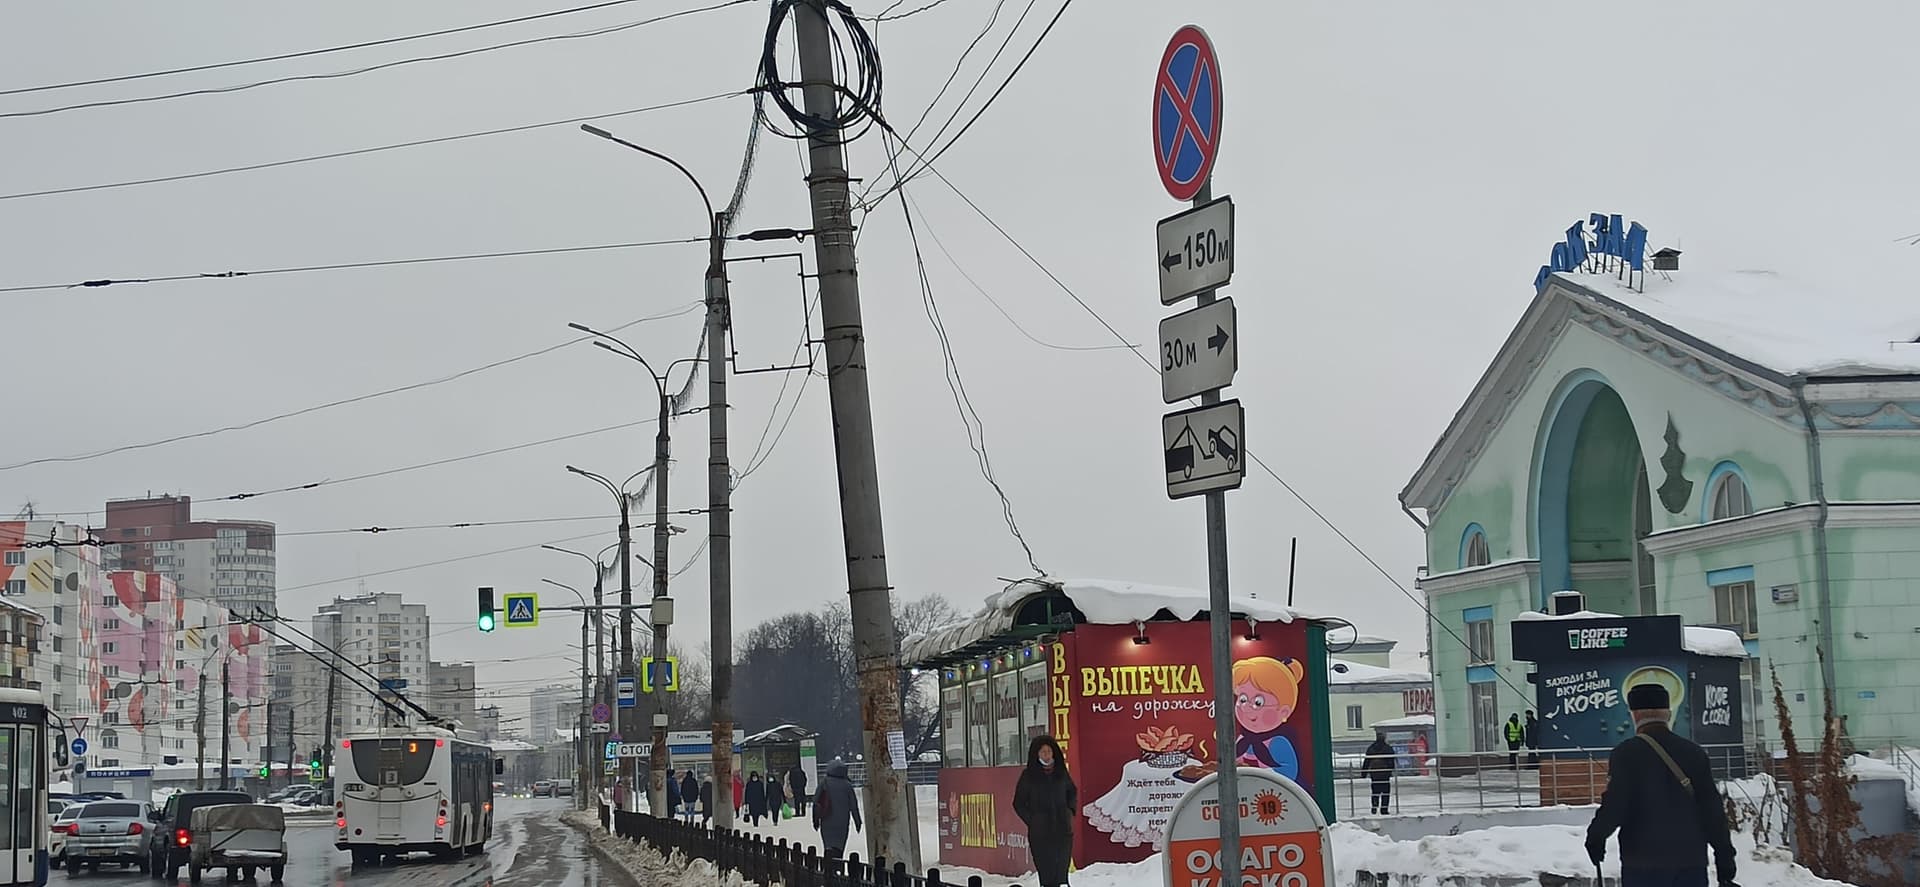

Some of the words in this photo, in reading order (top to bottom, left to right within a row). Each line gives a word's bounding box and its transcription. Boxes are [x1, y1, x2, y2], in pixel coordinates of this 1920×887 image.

[1580, 627, 1628, 640] COFFEE
[1580, 639, 1609, 649] LIKE
[1080, 664, 1205, 697] ВЫПЕЧКА
[1545, 672, 1584, 688] ЗАХОДИ
[1585, 670, 1599, 680] ЗА
[1556, 678, 1611, 697] ВКУСНЫМ
[1403, 689, 1433, 712] ПЕРРО
[1563, 689, 1619, 715] КОФЕ
[1704, 684, 1729, 709] КОФЕ
[1092, 700, 1124, 713] на
[620, 744, 652, 756] СТОП
[1202, 803, 1249, 821] COD
